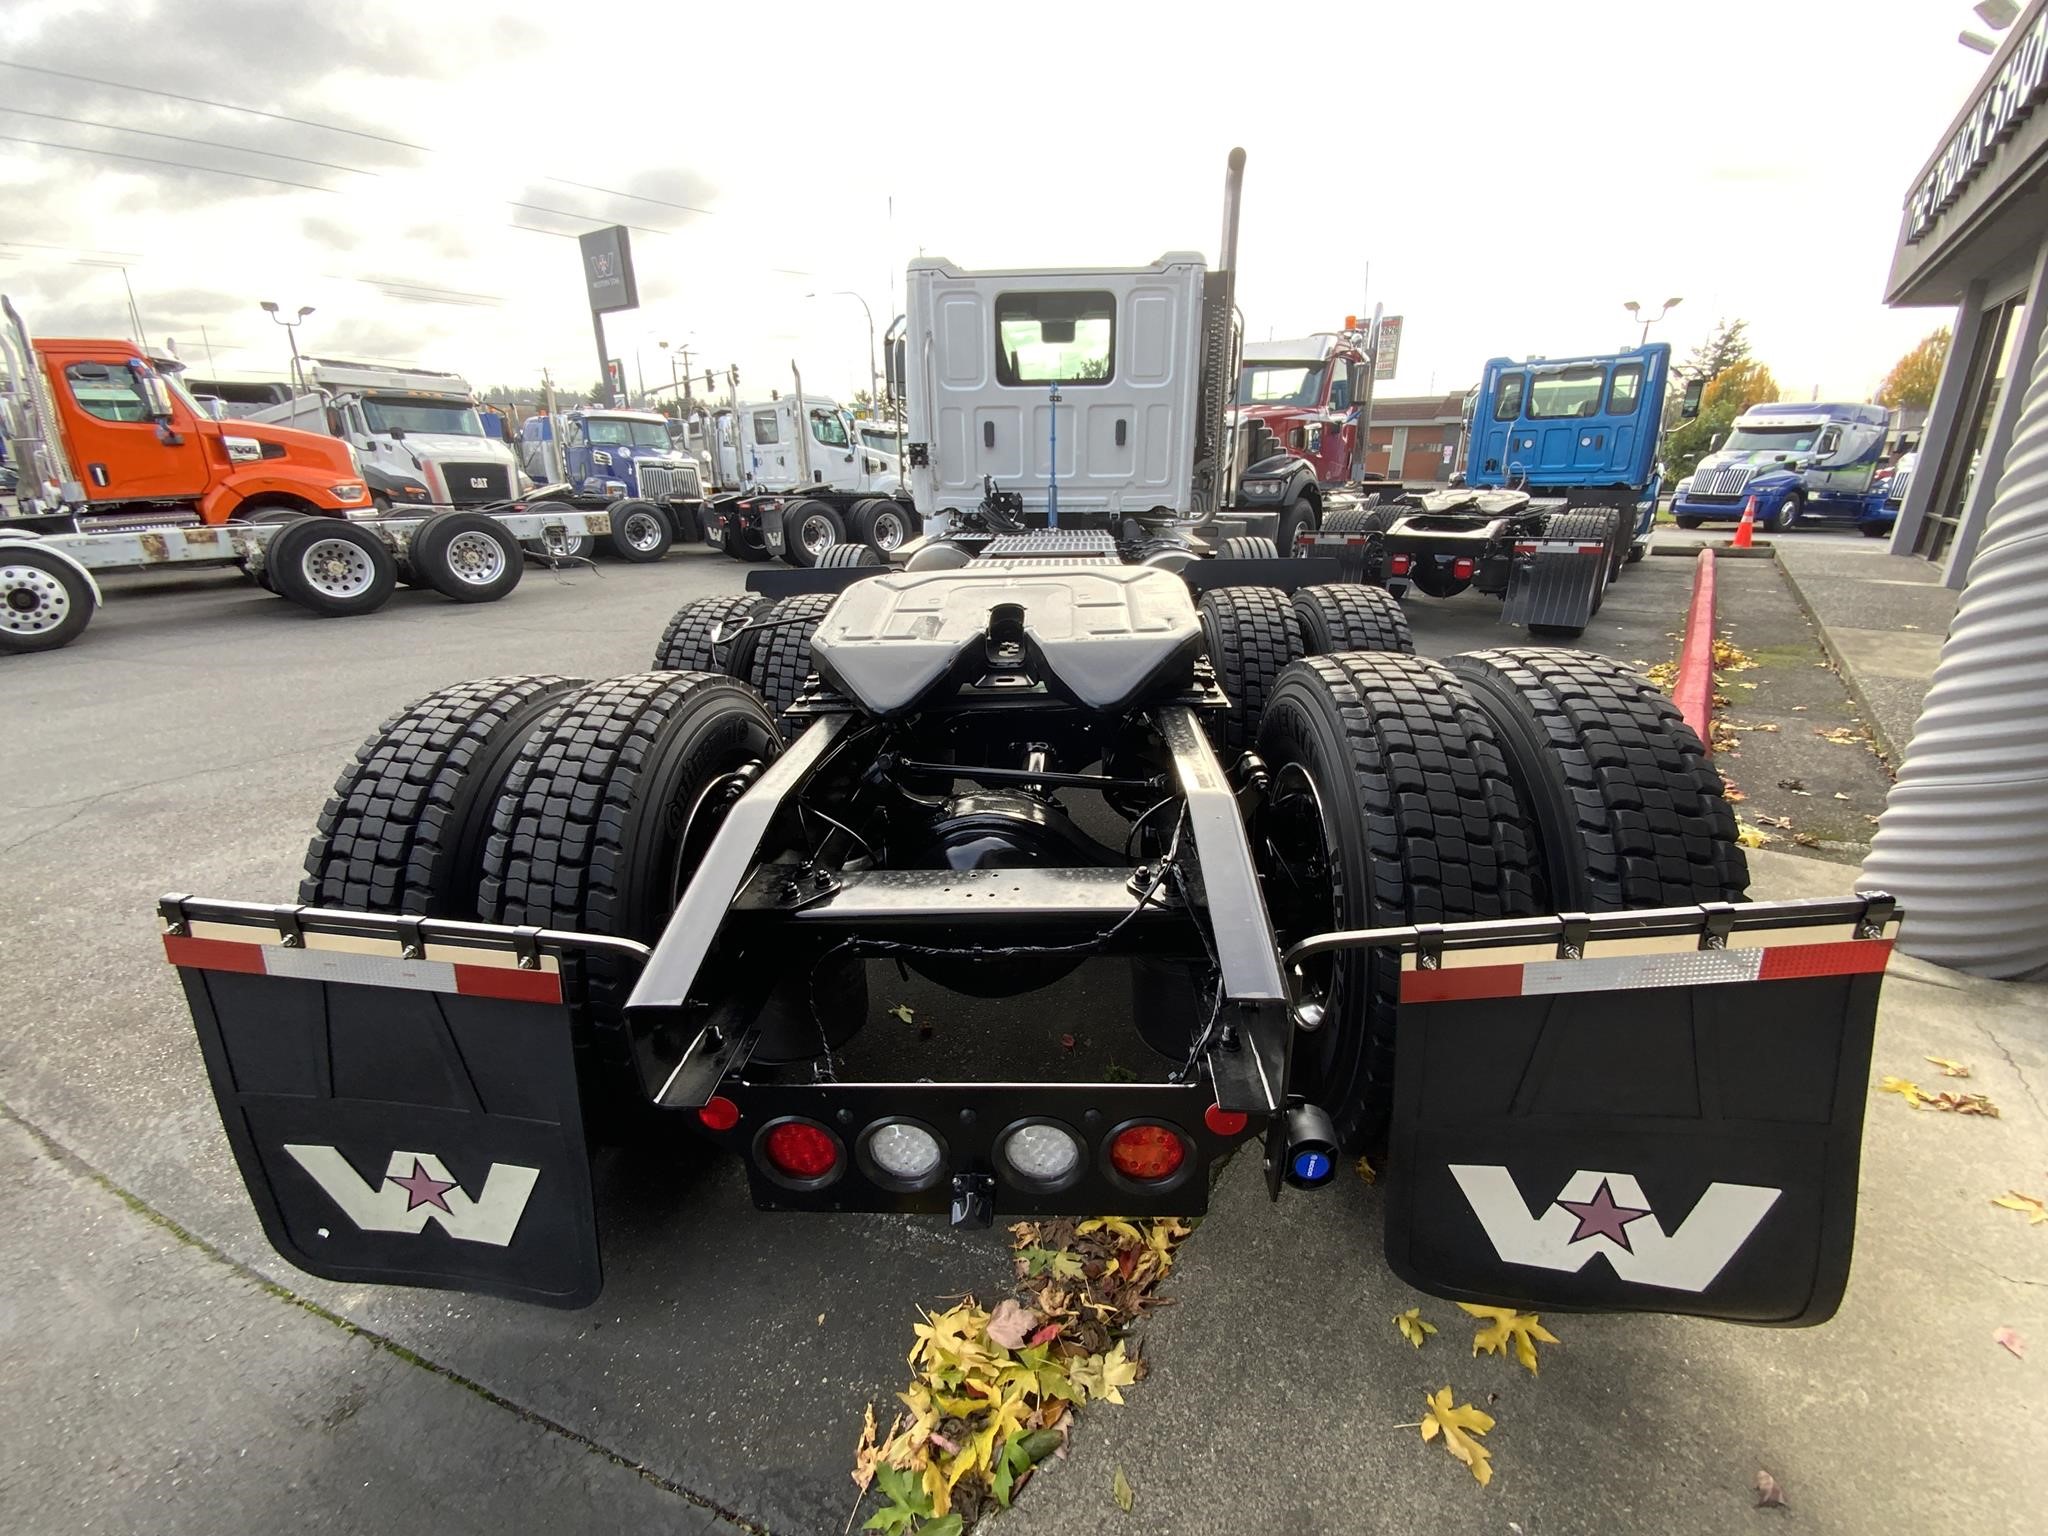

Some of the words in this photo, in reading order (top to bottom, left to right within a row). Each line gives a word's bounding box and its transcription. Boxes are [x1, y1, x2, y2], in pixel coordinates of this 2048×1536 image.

[1908, 172, 1937, 241] THE
[1929, 88, 1992, 215] TRUCK
[1985, 9, 2048, 148] SHO
[470, 477, 488, 489] CAT
